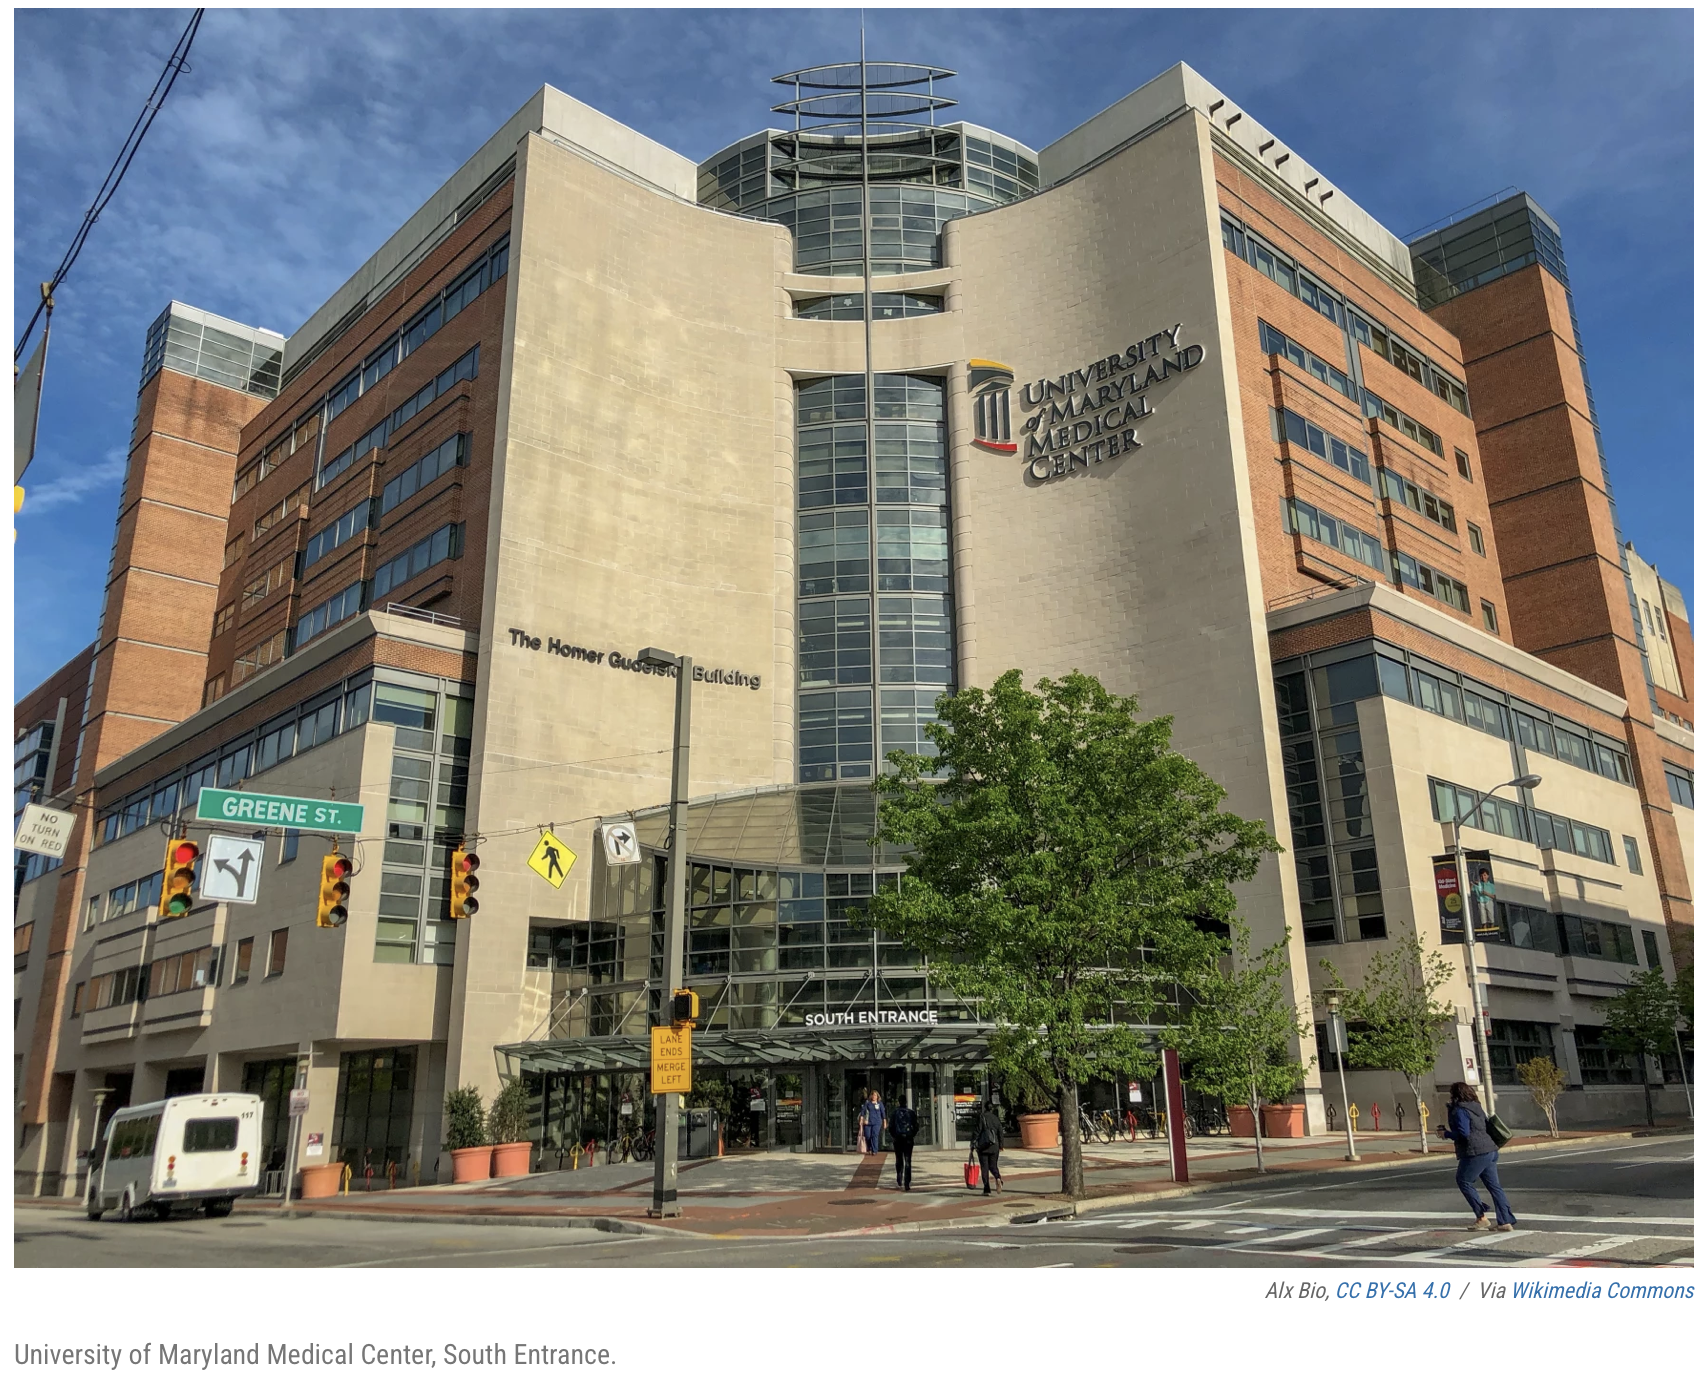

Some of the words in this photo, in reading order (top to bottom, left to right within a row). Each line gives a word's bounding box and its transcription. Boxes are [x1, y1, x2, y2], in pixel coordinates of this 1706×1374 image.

[1024, 323, 1183, 405] UNIVERSITY
[1026, 408, 1046, 432] of
[1049, 344, 1205, 425] MARYLAND
[1027, 395, 1155, 458] MEDICAL
[1029, 428, 1143, 481] CENTER
[508, 628, 542, 651] The
[547, 636, 605, 665] Homer
[692, 665, 762, 690] Building
[40, 813, 58, 824] NO
[222, 797, 308, 823] GREENE
[314, 808, 342, 825] ST.
[31, 823, 61, 838] TURN
[19, 834, 36, 845] ON
[40, 838, 62, 851] RED
[805, 1012, 854, 1026] SOUTH
[858, 1010, 938, 1024] ENTRANCE
[660, 1035, 683, 1044] LANE
[660, 1047, 683, 1056] ENDS
[657, 1062, 686, 1072] MERGE
[661, 1075, 682, 1084] LEFT
[241, 1111, 254, 1119] 117
